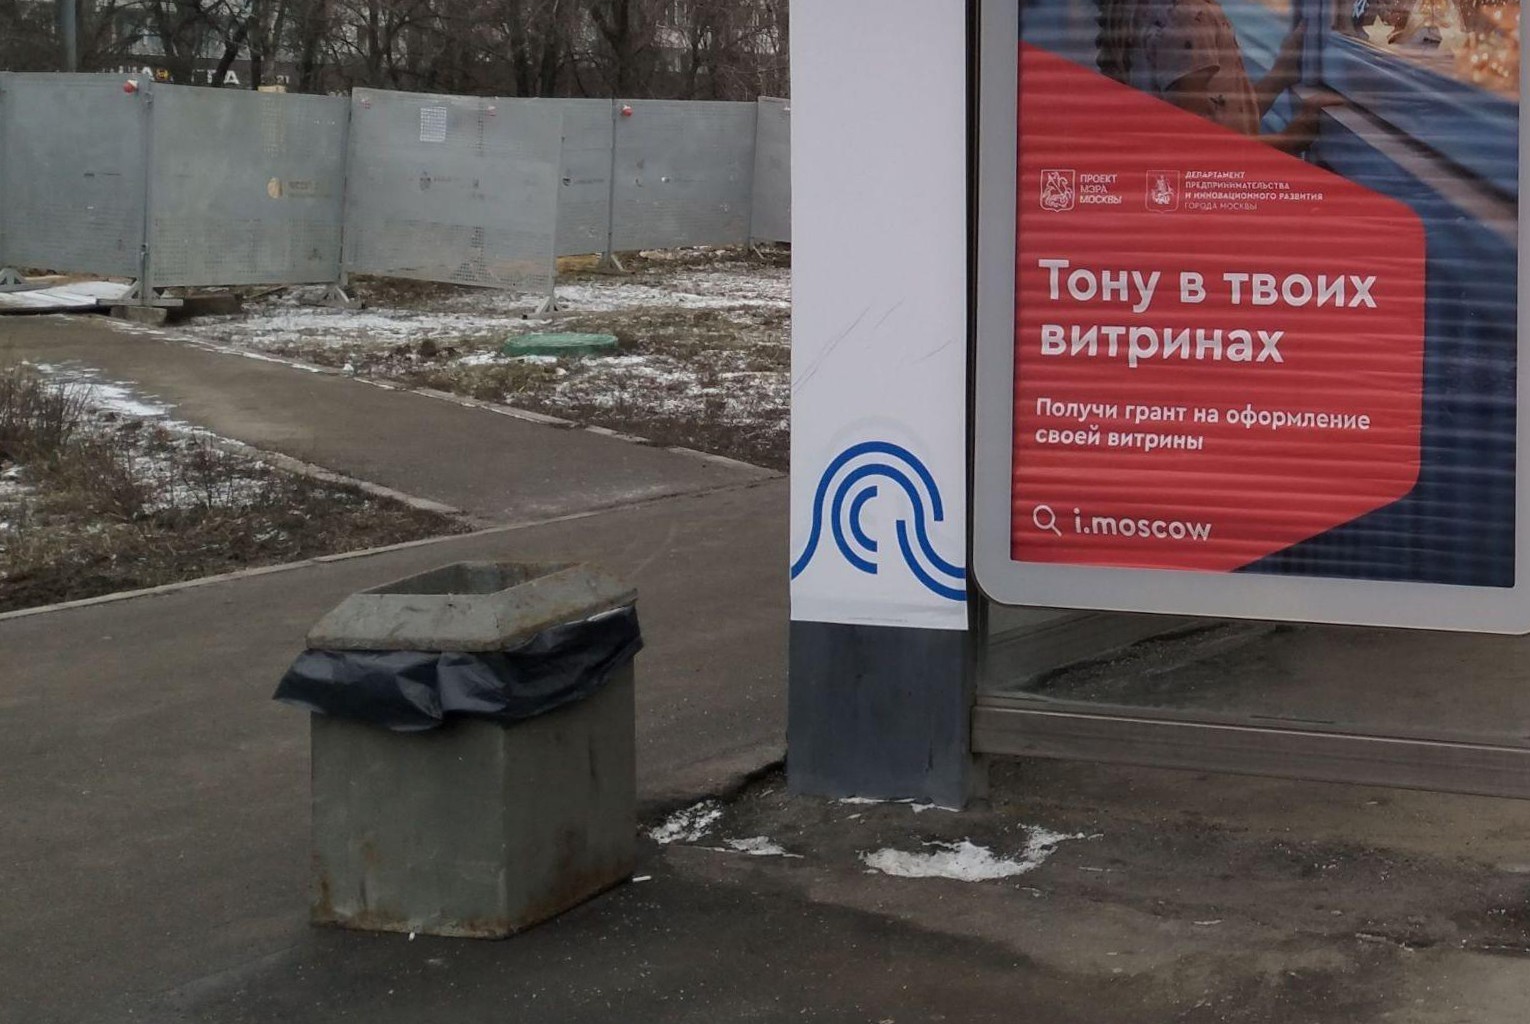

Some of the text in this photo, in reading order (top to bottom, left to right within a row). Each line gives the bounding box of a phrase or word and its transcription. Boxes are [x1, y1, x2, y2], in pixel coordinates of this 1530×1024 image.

[1080, 174, 1117, 184] ПРОЕКТ
[1185, 171, 1245, 179] ДЕПАРТАМЕНТ
[1080, 184, 1108, 194] МЭРА
[1185, 181, 1290, 190] ПРЕДПРИНИМАТЕЛЬСТВА
[1079, 194, 1122, 204] МОСКВЫ
[1193, 192, 1277, 200] ИННОВАЦИОННОГО
[1279, 193, 1323, 201] РАЗВИТИЯ
[1184, 201, 1257, 211] ГОРОДА МОСКВЫ
[1038, 259, 1377, 313] Тону в твоих
[1040, 324, 1285, 368] витринах
[1036, 398, 1371, 430] Получи грант на оформление
[1035, 425, 1204, 452] своей витрины
[1073, 507, 1212, 541] i.moscow
